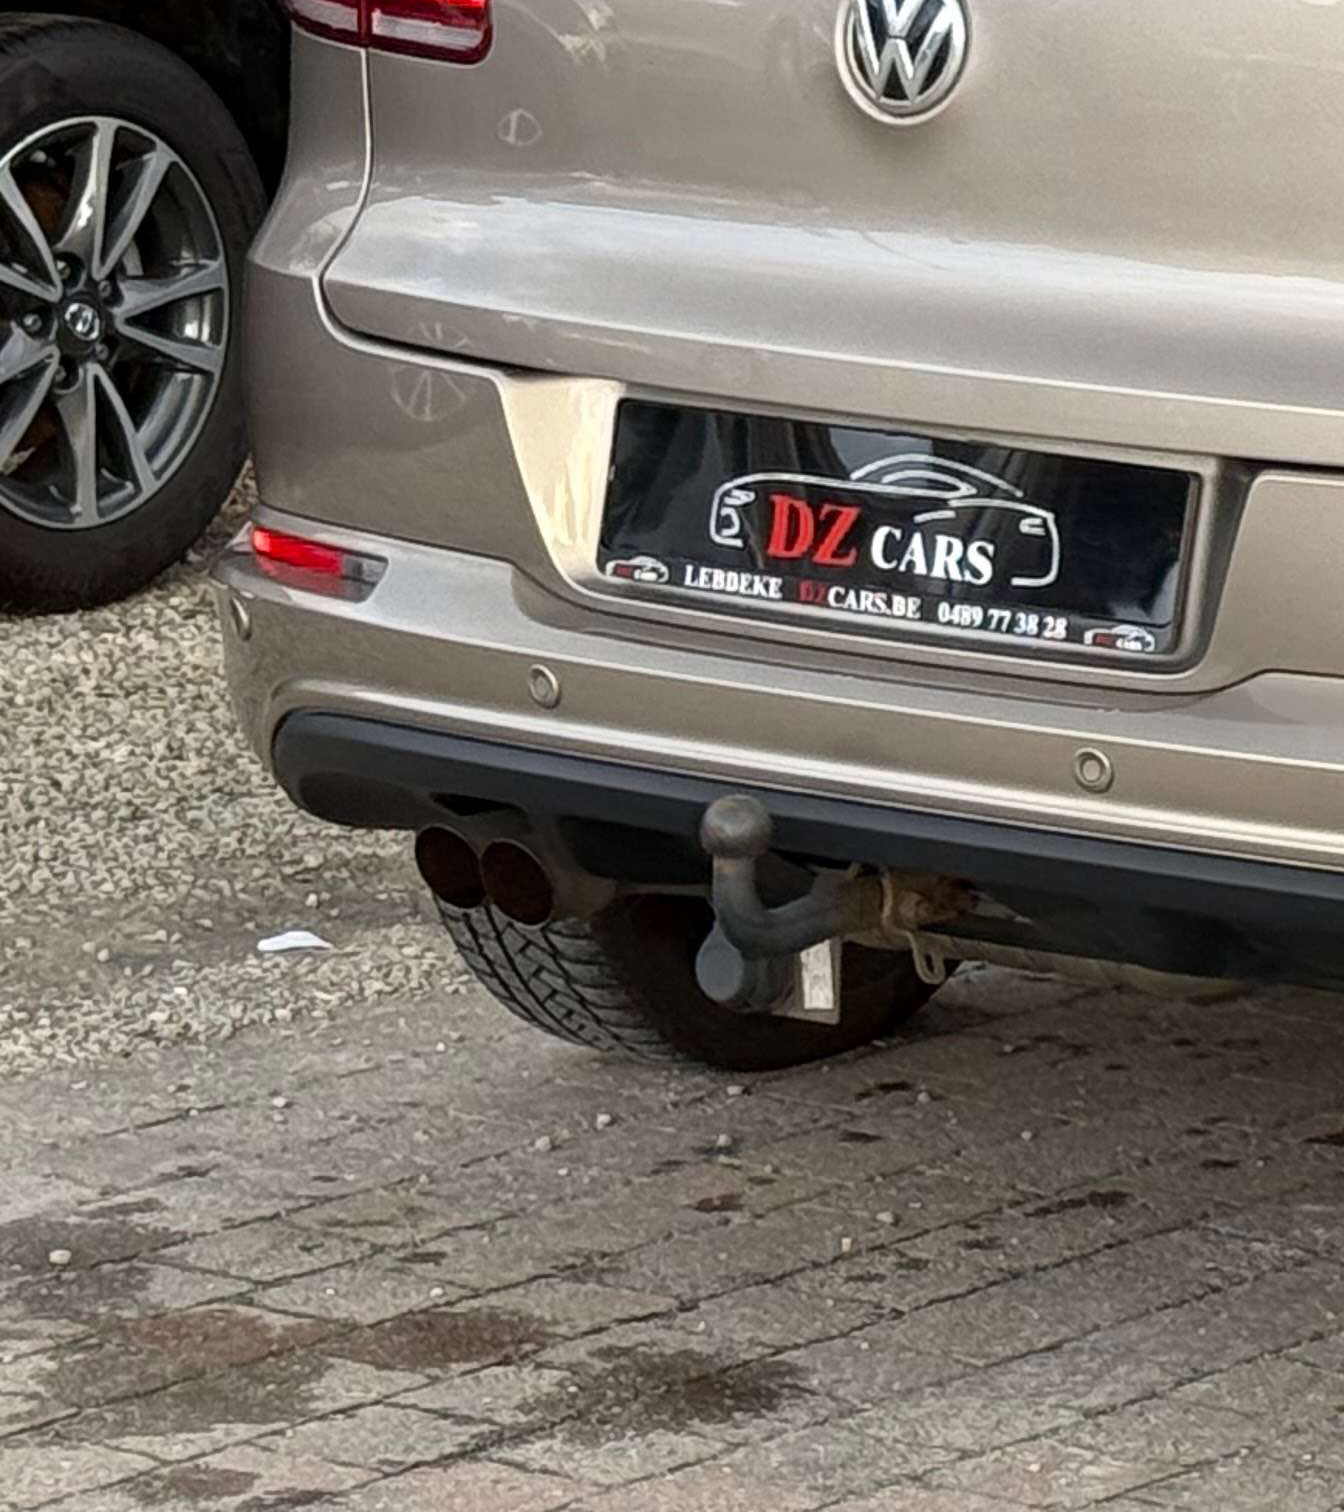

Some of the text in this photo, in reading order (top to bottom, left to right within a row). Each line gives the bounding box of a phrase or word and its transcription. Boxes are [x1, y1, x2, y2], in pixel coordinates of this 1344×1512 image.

[766, 493, 996, 586] DZ CARS
[937, 600, 984, 628] 0489
[987, 607, 1013, 633] 77
[1013, 611, 1040, 636] 38
[1042, 614, 1069, 640] 28
